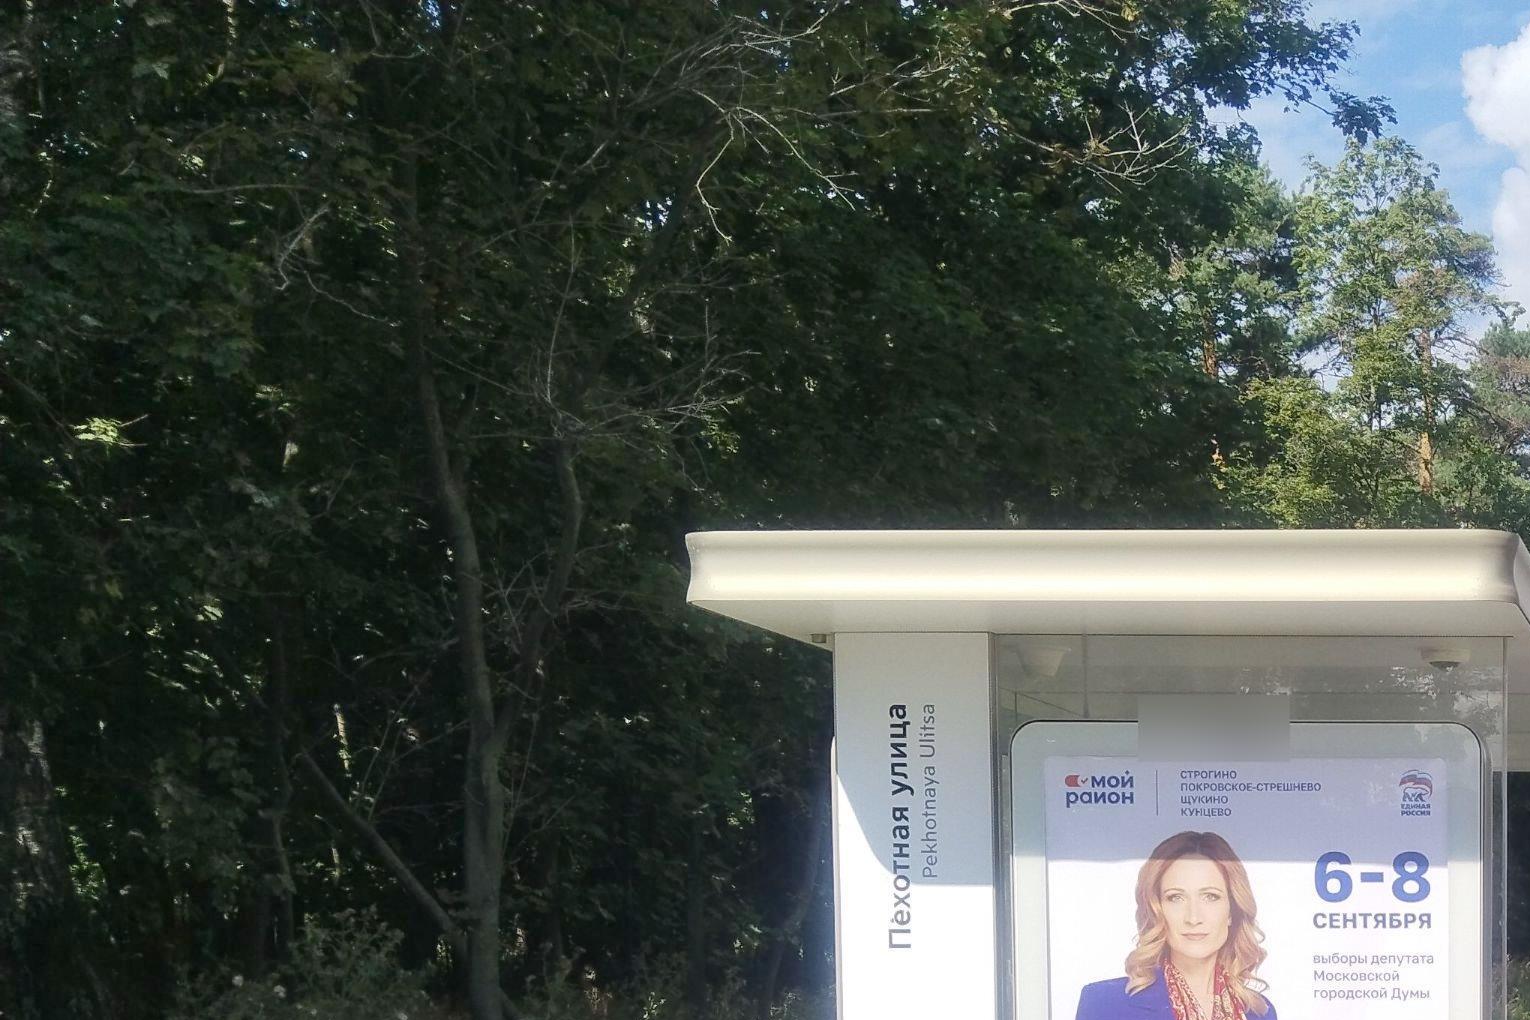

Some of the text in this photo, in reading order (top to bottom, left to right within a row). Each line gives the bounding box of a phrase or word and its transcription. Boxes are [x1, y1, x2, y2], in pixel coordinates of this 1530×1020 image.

[889, 703, 914, 796] улица
[1180, 770, 1237, 779] СТРОГИНО
[918, 703, 940, 878] Pekhotnaya Ulitsa
[1180, 782, 1321, 792] ПОКРОВСКОЕ-СТРЕШНЕВО
[1181, 796, 1228, 805] ЩУКИНО
[1181, 808, 1232, 817] КУНЦЕВО
[1312, 912, 1432, 929] СЕНТЯБРЯ
[1313, 953, 1434, 967] выборы депутата
[1313, 970, 1400, 981] Московской
[1313, 988, 1430, 1001] городской Думы
